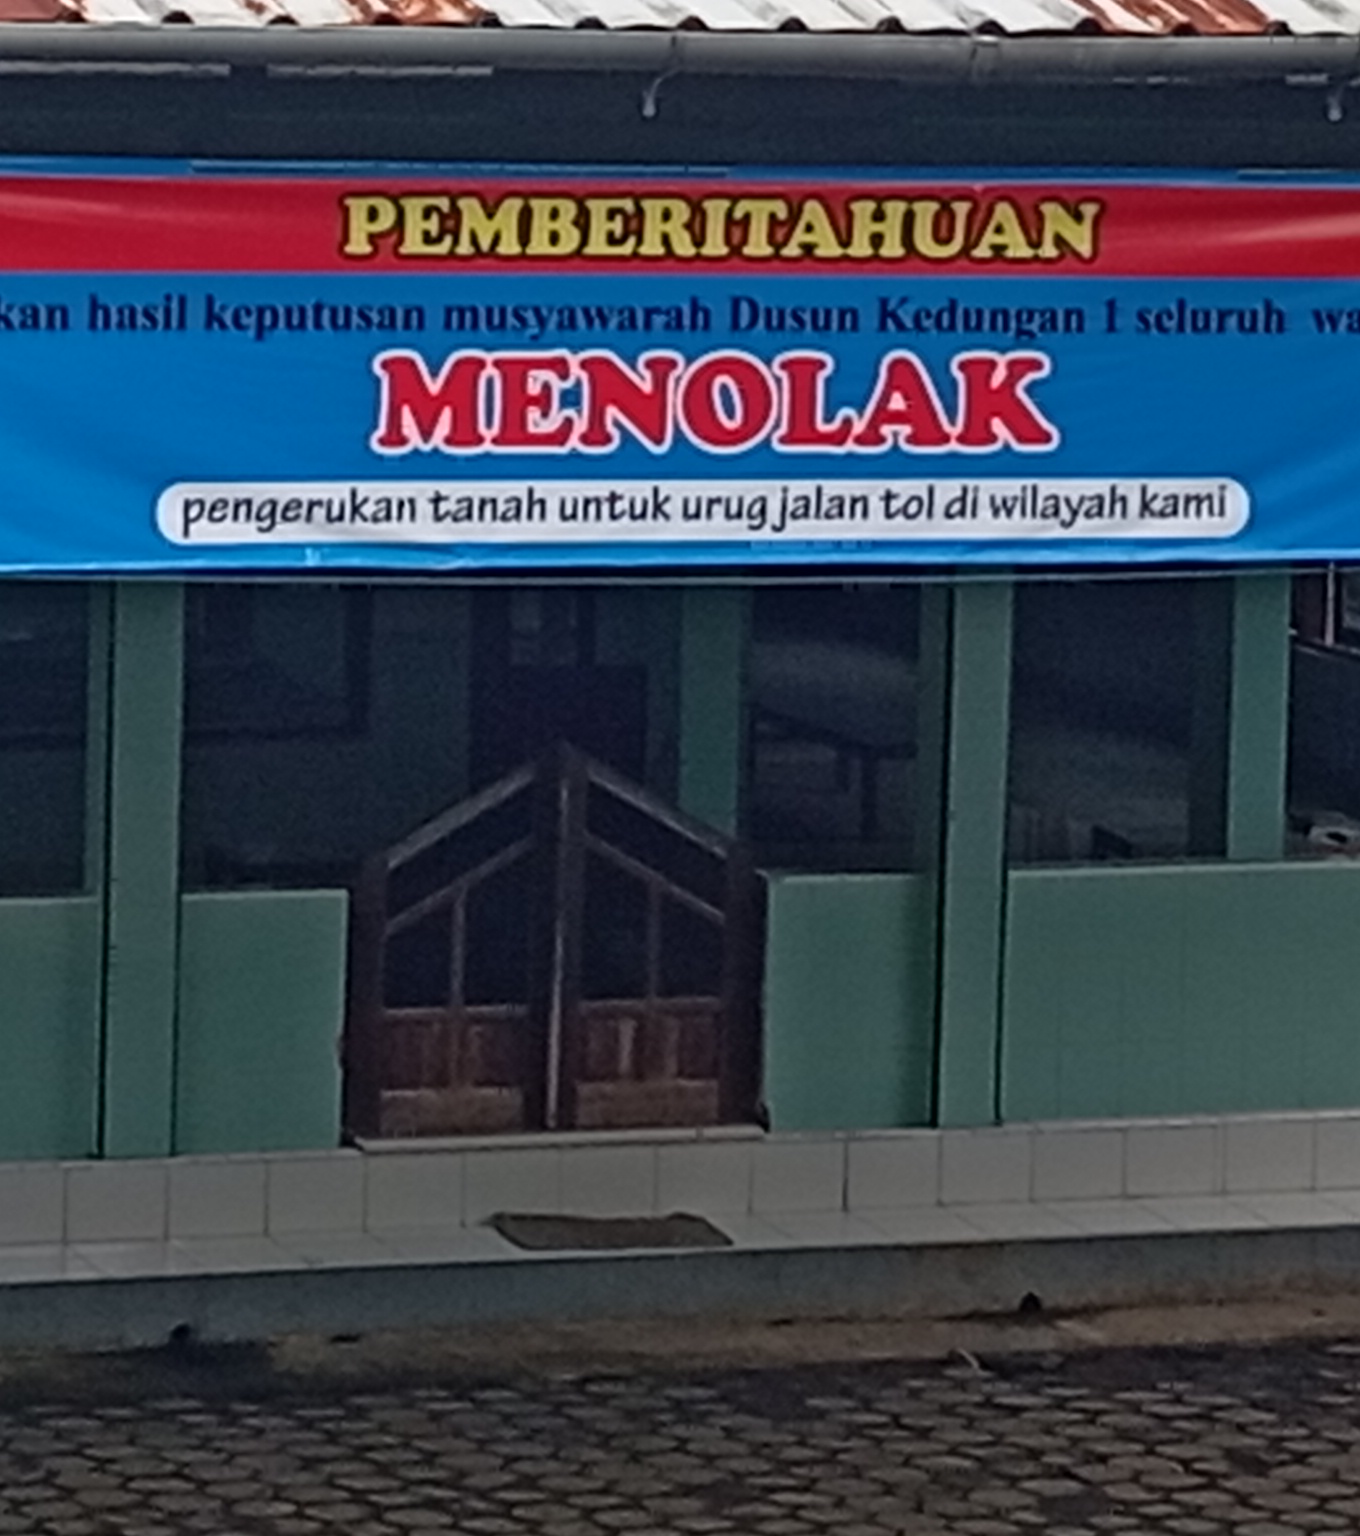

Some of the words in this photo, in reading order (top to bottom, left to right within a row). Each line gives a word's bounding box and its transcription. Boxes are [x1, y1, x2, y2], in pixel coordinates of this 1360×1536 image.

[340, 194, 1101, 261] PEMBERITAHUAN
[87, 294, 187, 331] hasil
[205, 294, 426, 340] keputusan
[443, 294, 710, 340] musyawarah
[729, 296, 859, 332] Dusun
[877, 296, 1085, 340] Kedungan
[1136, 298, 1286, 335] seluruh
[372, 349, 1061, 454] MENOLAK
[182, 486, 417, 539] pengerukan
[429, 486, 547, 524] tanah
[559, 485, 672, 523] untuk
[681, 490, 767, 530] urug
[771, 484, 869, 532] jalan
[880, 484, 935, 520] tol
[943, 484, 980, 520] di
[988, 483, 1129, 529] wilayah
[1140, 483, 1228, 520] kami
